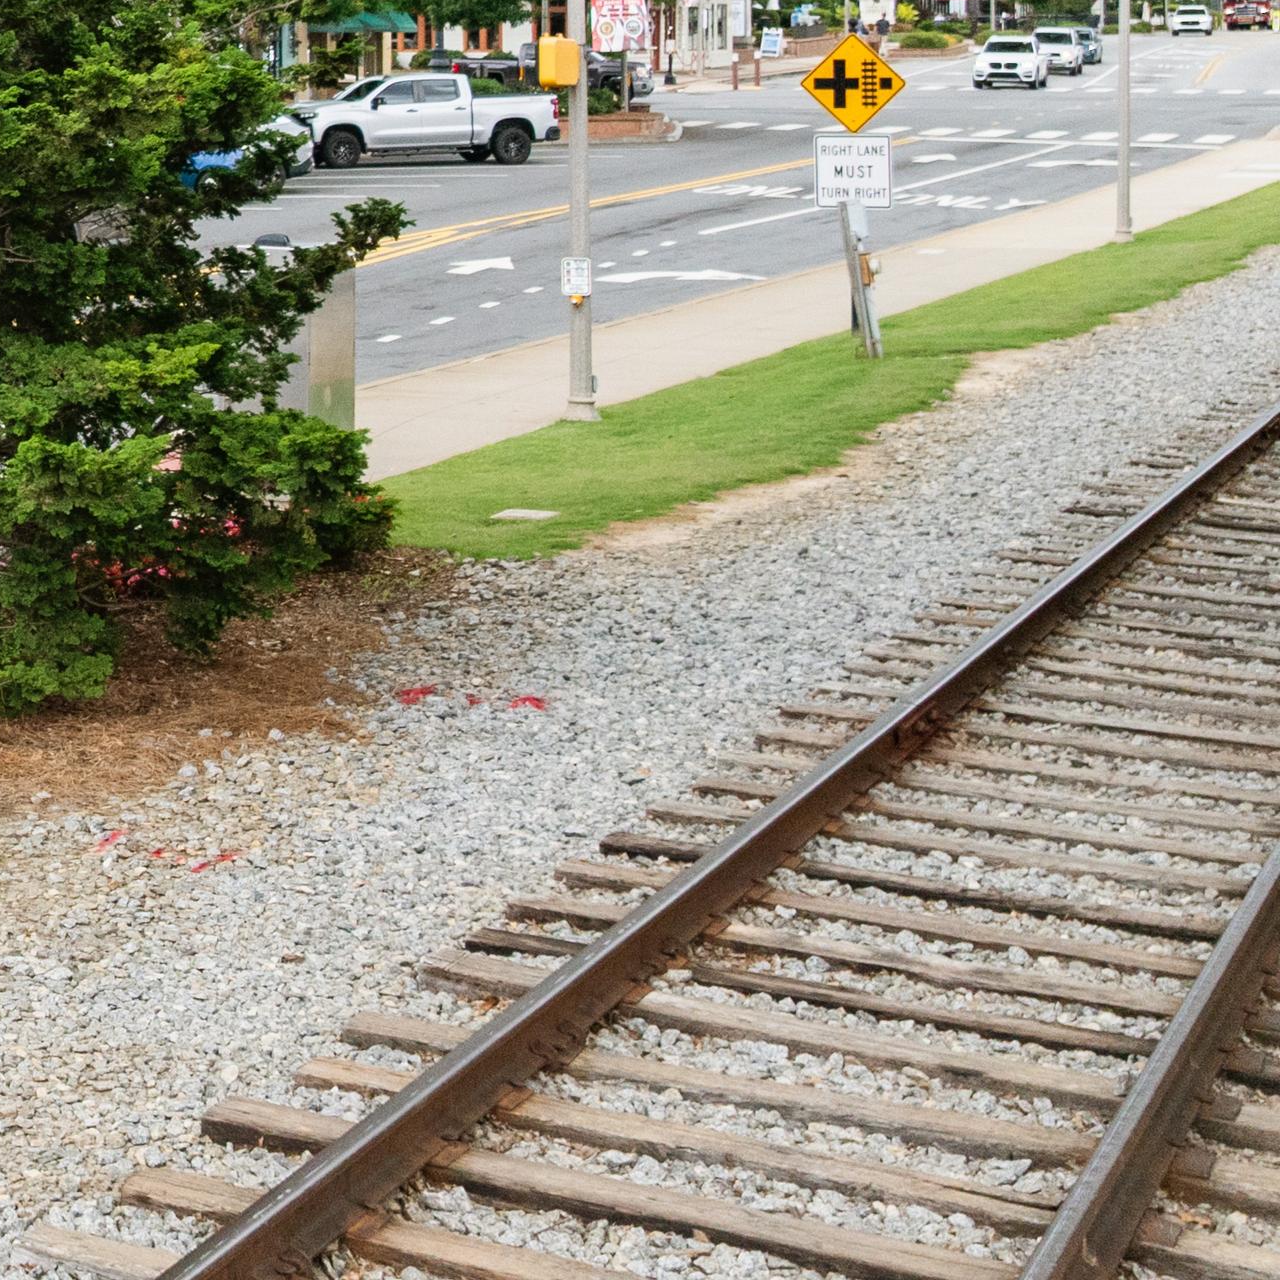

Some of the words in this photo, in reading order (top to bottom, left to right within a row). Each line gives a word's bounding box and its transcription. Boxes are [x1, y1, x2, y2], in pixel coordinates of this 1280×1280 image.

[820, 145, 852, 156] RIGHT
[857, 145, 886, 156] LANE
[834, 165, 873, 179] MUST
[821, 187, 849, 198] TURN
[855, 187, 887, 199] RIGHT
